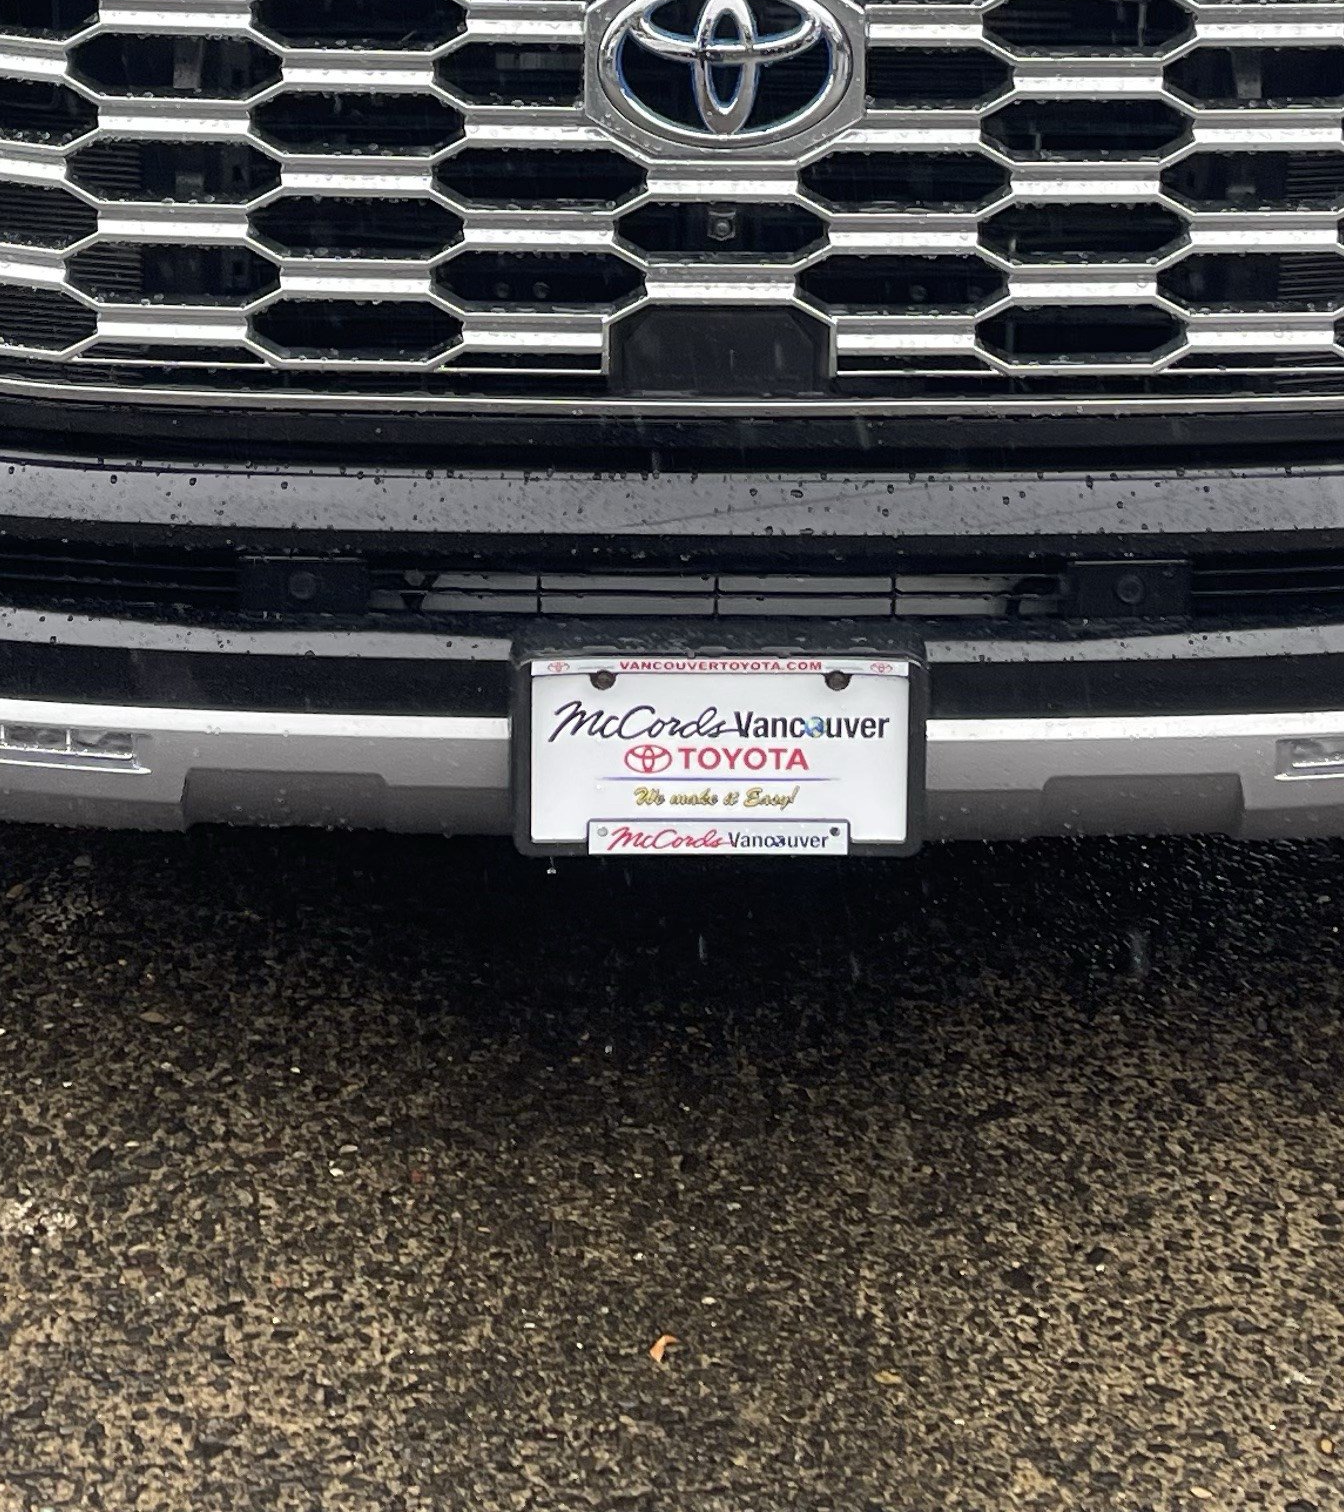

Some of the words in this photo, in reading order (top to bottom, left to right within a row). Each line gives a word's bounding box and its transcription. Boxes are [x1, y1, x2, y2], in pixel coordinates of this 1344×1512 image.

[619, 660, 823, 671] VANCOUVERTOYOTA.COM
[547, 700, 727, 743] McCords
[677, 747, 810, 770] TOYOTA
[633, 786, 666, 806] We
[669, 787, 719, 806] make
[743, 784, 801, 811] Easy!
[606, 826, 725, 851] McCords
